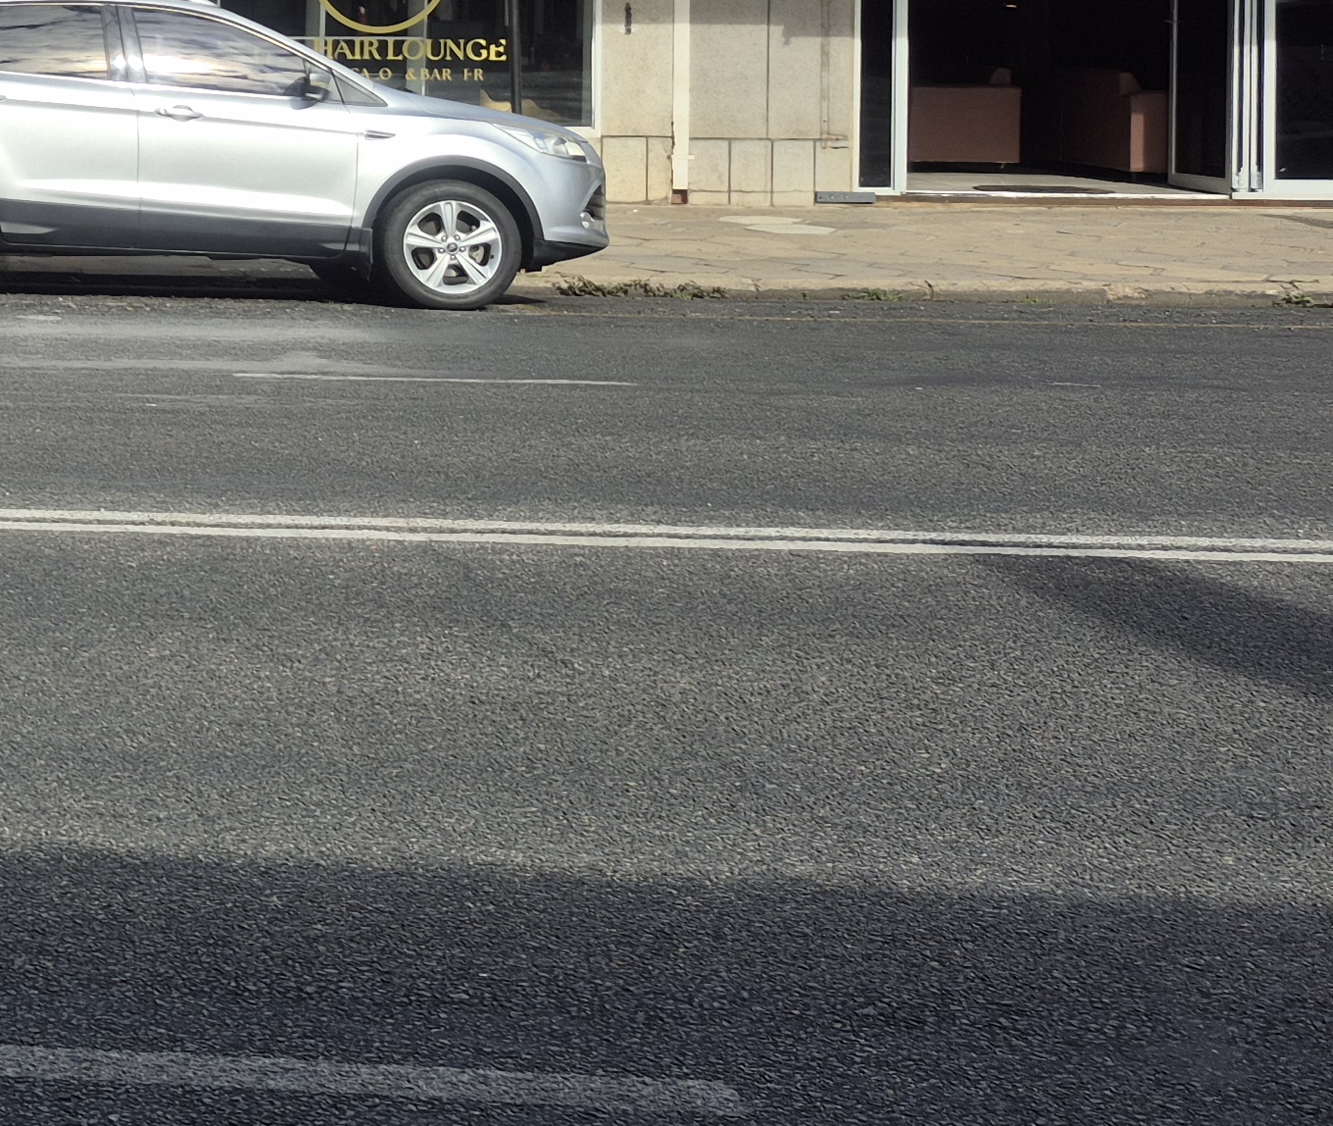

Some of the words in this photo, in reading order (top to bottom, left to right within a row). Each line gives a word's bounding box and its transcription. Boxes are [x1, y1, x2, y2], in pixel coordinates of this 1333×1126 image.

[313, 38, 381, 60] HAIR
[386, 38, 507, 61] LOUNGE
[405, 68, 417, 80] &
